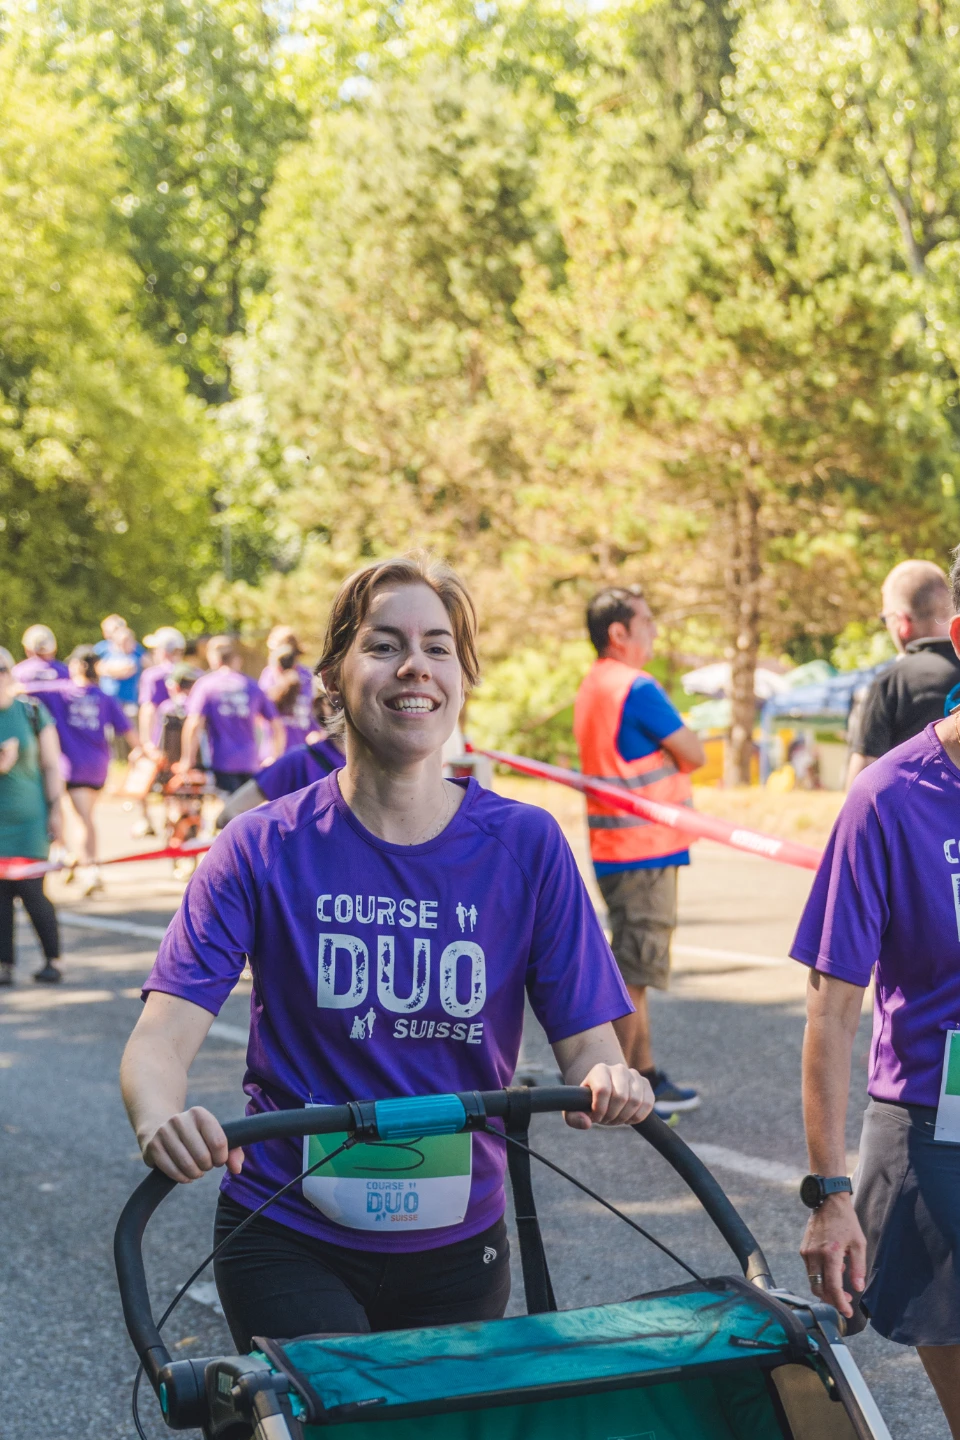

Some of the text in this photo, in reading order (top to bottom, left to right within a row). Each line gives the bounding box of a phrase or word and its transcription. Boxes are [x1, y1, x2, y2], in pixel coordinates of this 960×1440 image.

[316, 894, 438, 929] COURSE
[316, 933, 487, 1018] DUO
[393, 1019, 484, 1044] SUISSE
[366, 1182, 405, 1190] COURSE
[366, 1192, 419, 1213] DUO
[390, 1214, 419, 1222] SUISSE
